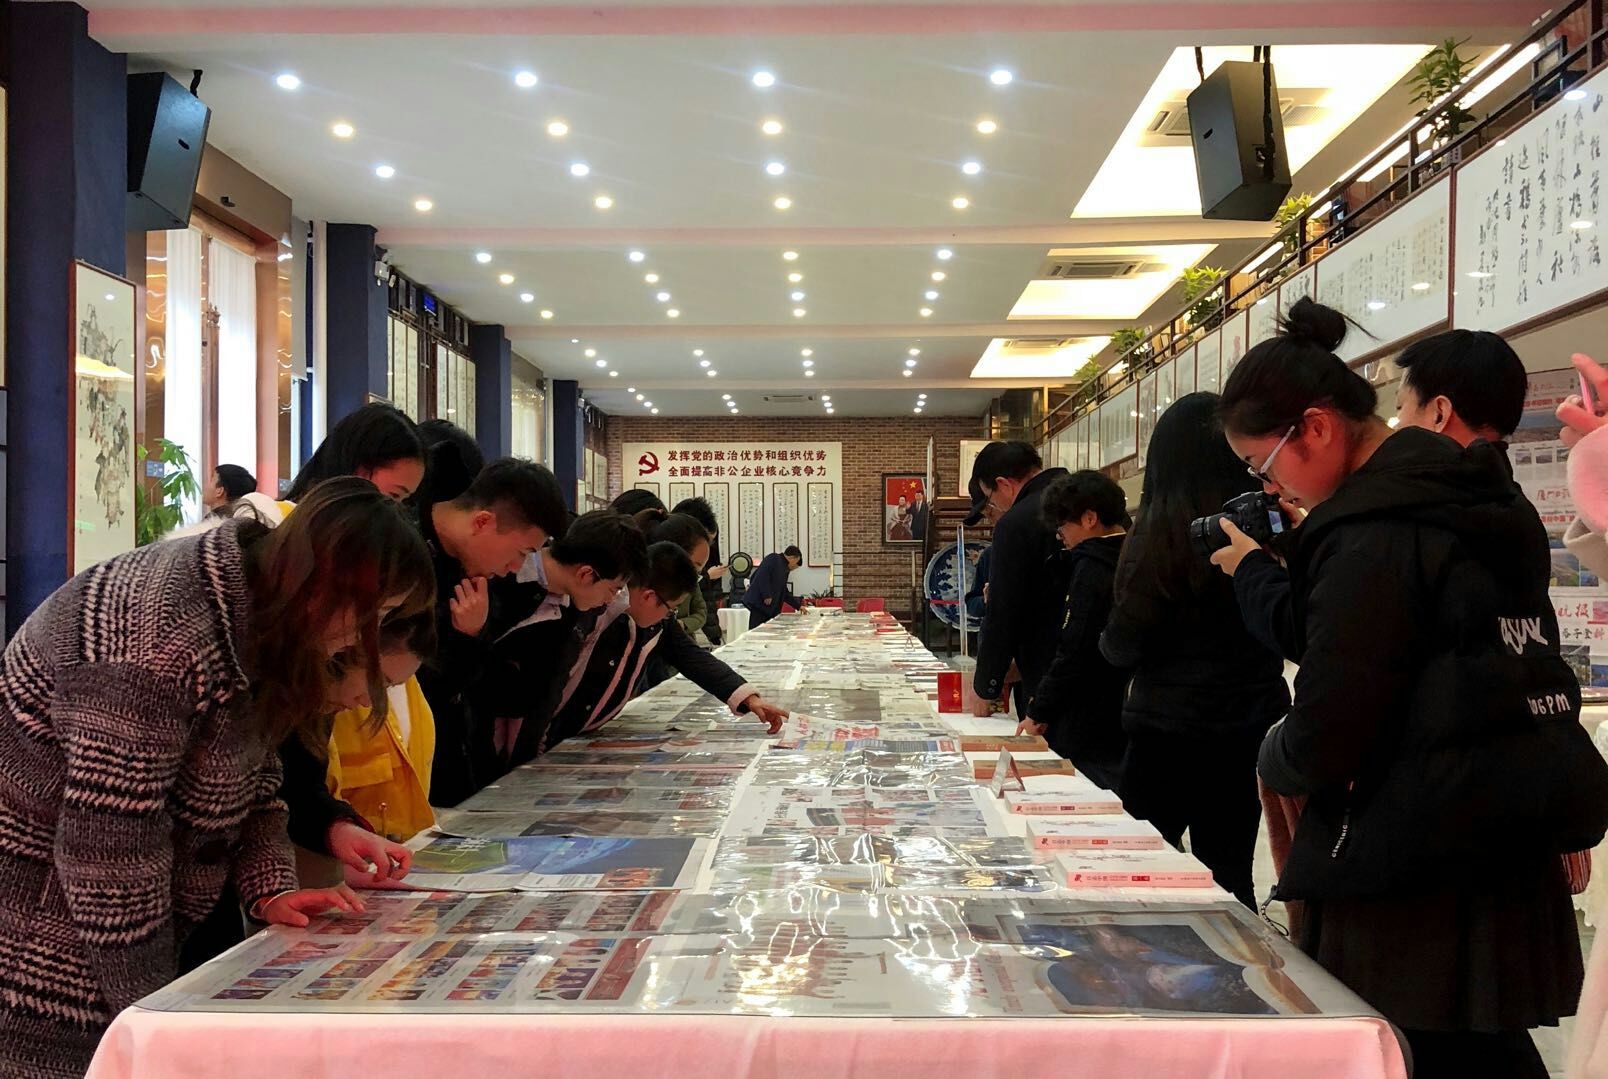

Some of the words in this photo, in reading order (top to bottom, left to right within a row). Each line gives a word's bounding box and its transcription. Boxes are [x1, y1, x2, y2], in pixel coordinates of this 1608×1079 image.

[668, 450, 827, 462] 发挥党的政治优势和组织优势
[668, 466, 827, 477] 全面提高非公企业核心竞争力
